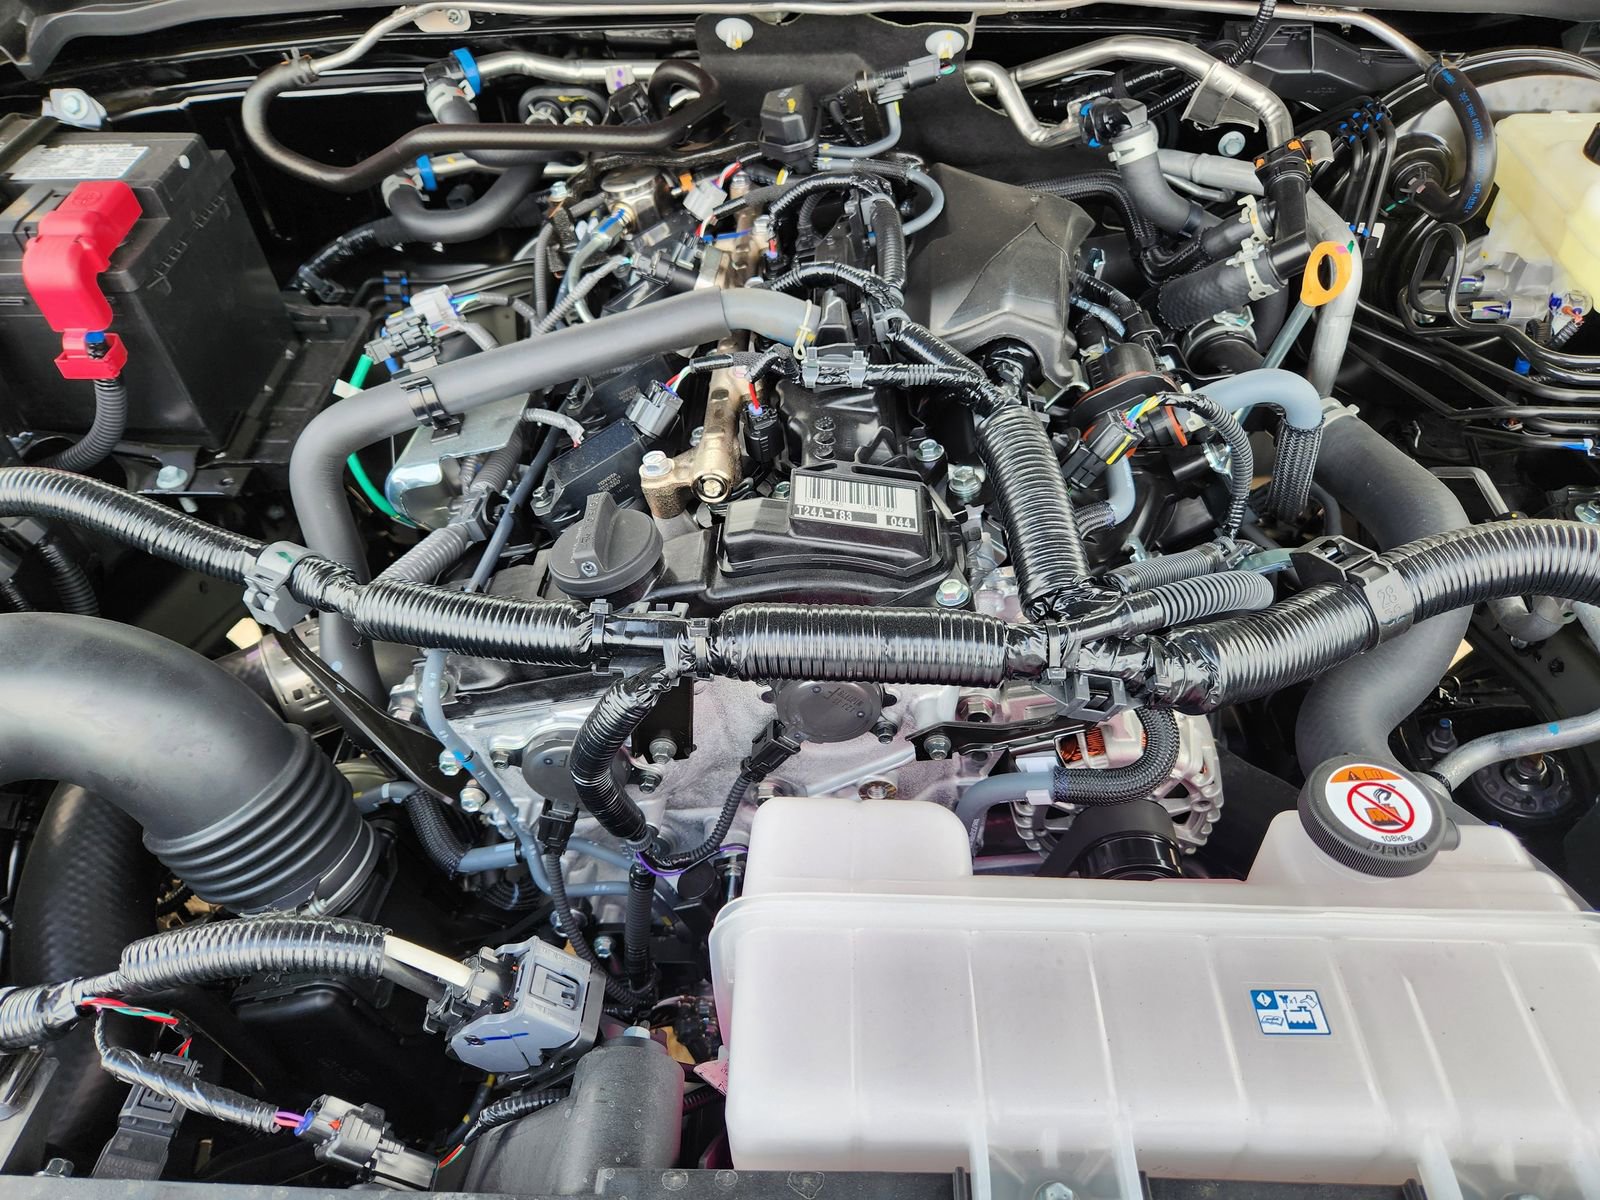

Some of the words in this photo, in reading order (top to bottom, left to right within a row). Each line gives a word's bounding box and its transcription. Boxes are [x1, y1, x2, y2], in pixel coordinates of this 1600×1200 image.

[796, 505, 853, 521] T24A-T83
[890, 516, 912, 528] 044
[1380, 834, 1414, 843] 108kPa
[1366, 841, 1428, 857] DENSO
